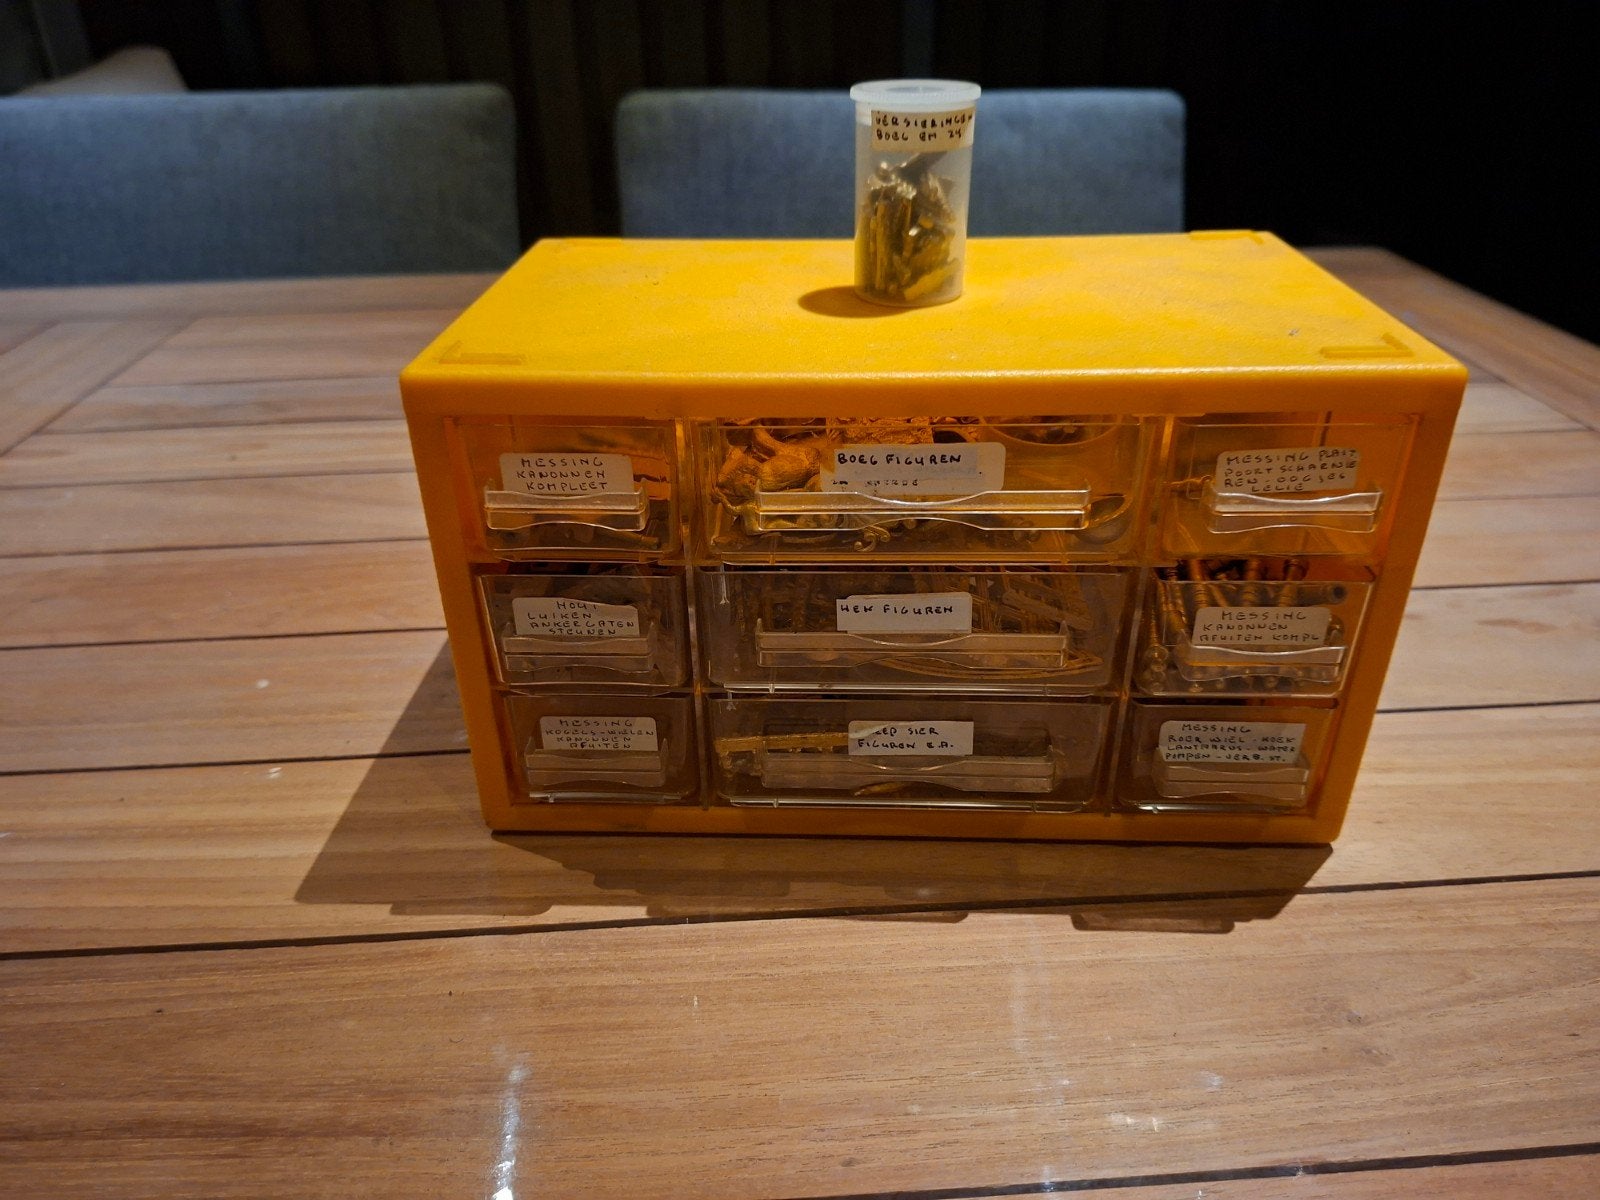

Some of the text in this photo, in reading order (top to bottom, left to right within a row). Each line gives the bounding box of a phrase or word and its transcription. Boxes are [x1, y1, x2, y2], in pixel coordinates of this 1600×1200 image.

[521, 457, 603, 467] MESSING
[837, 453, 962, 465] BOEG FIGUREN
[1226, 453, 1309, 465] MESSING
[516, 470, 606, 479] KANONNEN
[1224, 466, 1273, 477] POORT
[526, 482, 608, 491] KOMPLEET
[1251, 483, 1304, 492] LELIE
[883, 604, 953, 615] FIGUREN
[527, 612, 592, 620] LUIKEN
[1221, 611, 1307, 621] MESSING
[1202, 623, 1288, 631] KANONNEN
[559, 719, 633, 727] MESSING
[907, 727, 939, 735] SIER
[1181, 724, 1252, 733] MESSING
[857, 739, 915, 749] FIGUREN
